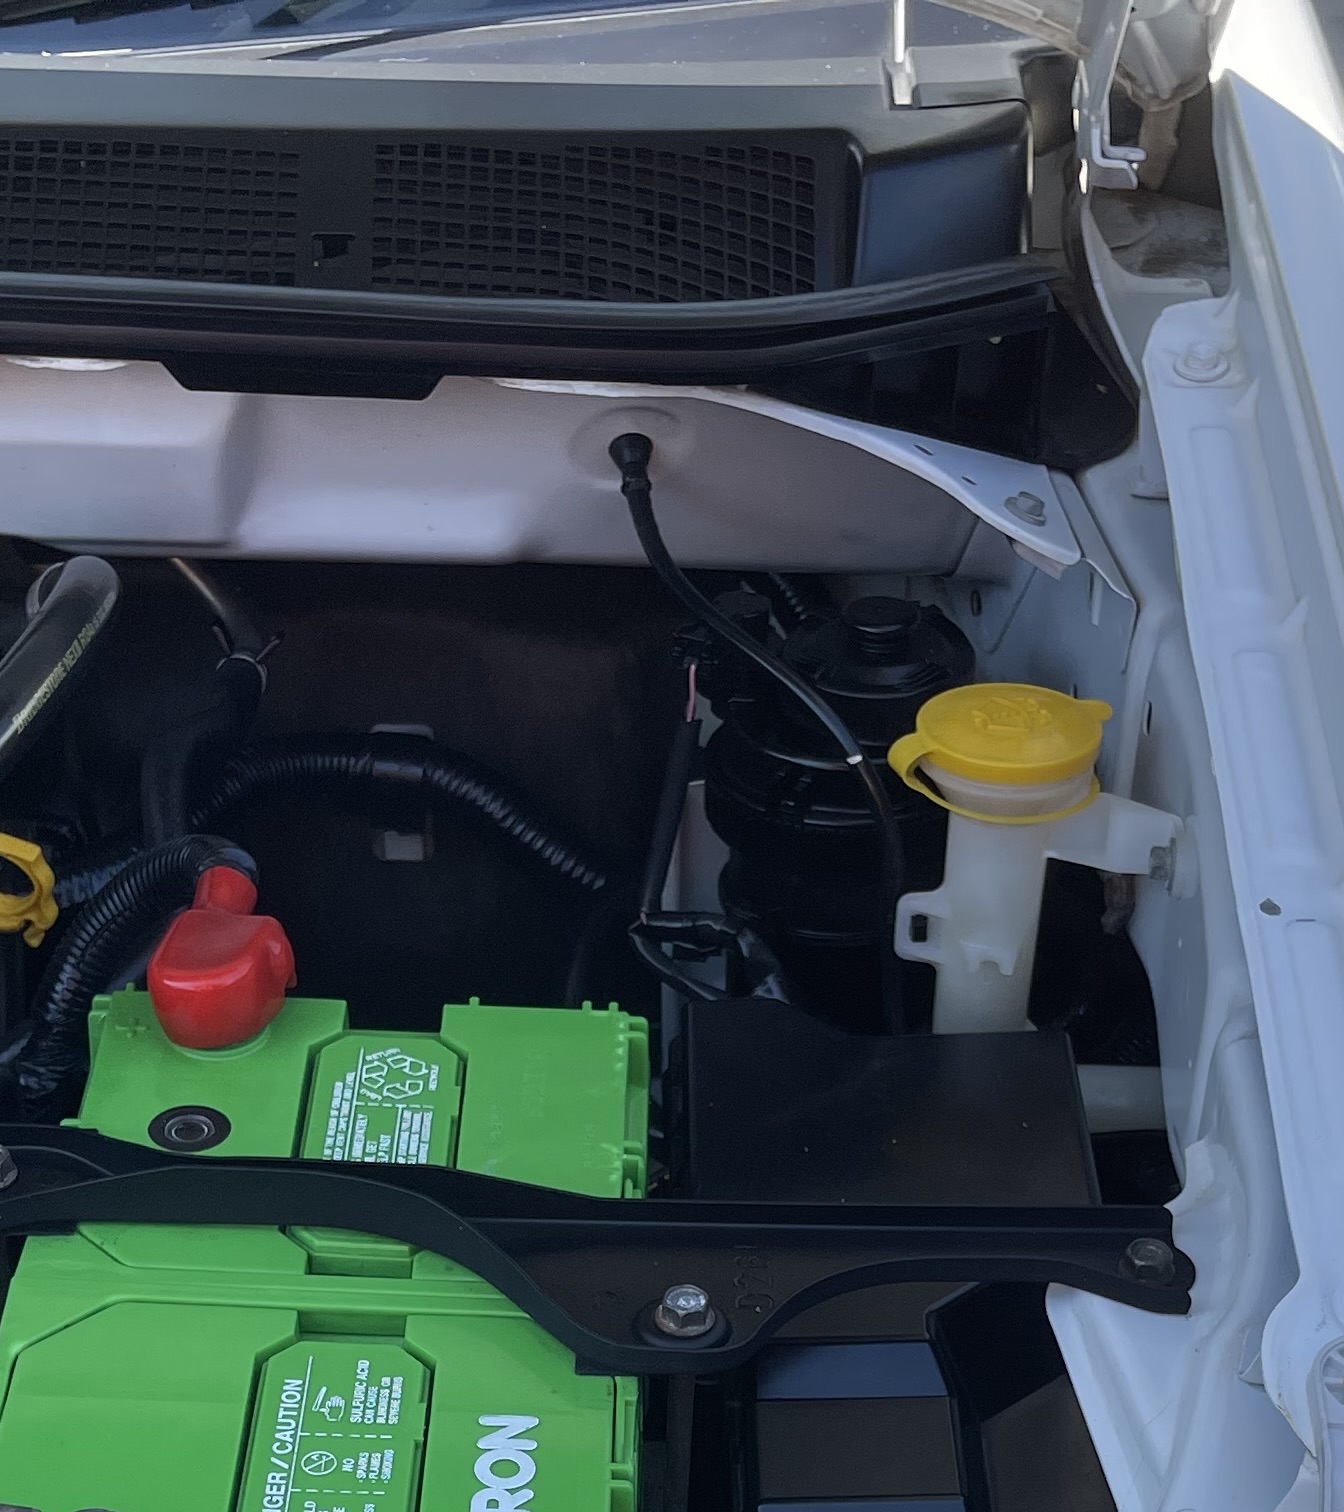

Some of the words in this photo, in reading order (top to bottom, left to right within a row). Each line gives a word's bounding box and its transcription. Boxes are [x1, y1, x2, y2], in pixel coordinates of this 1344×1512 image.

[355, 1359, 370, 1381] ACID
[349, 1381, 367, 1423] SULFURIC
[365, 1385, 379, 1408] CAUSE
[271, 1378, 304, 1458] CAUTION
[363, 1409, 375, 1425] CAN
[387, 1399, 401, 1425] SEVERE
[341, 1457, 355, 1472] NO
